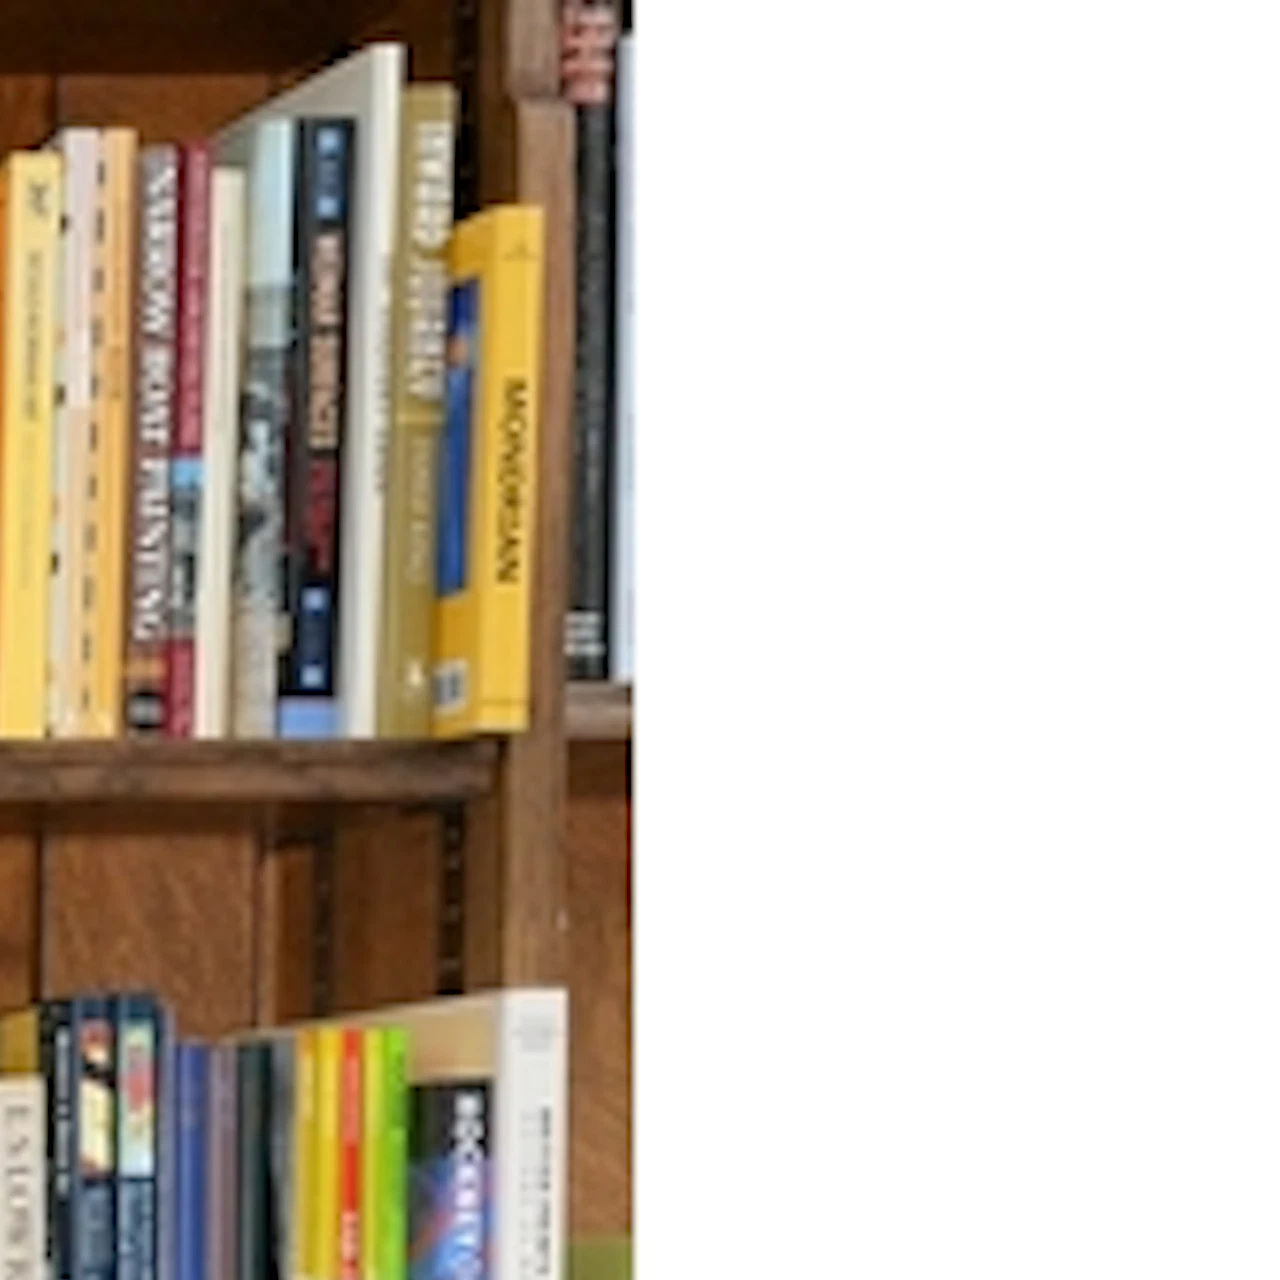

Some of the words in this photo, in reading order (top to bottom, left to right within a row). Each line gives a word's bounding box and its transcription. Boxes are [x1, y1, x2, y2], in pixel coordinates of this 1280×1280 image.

[141, 165, 179, 338] NARROW
[138, 350, 176, 446] BOAT
[494, 375, 529, 587] MONDRIAN
[131, 457, 172, 641] PAINTING
